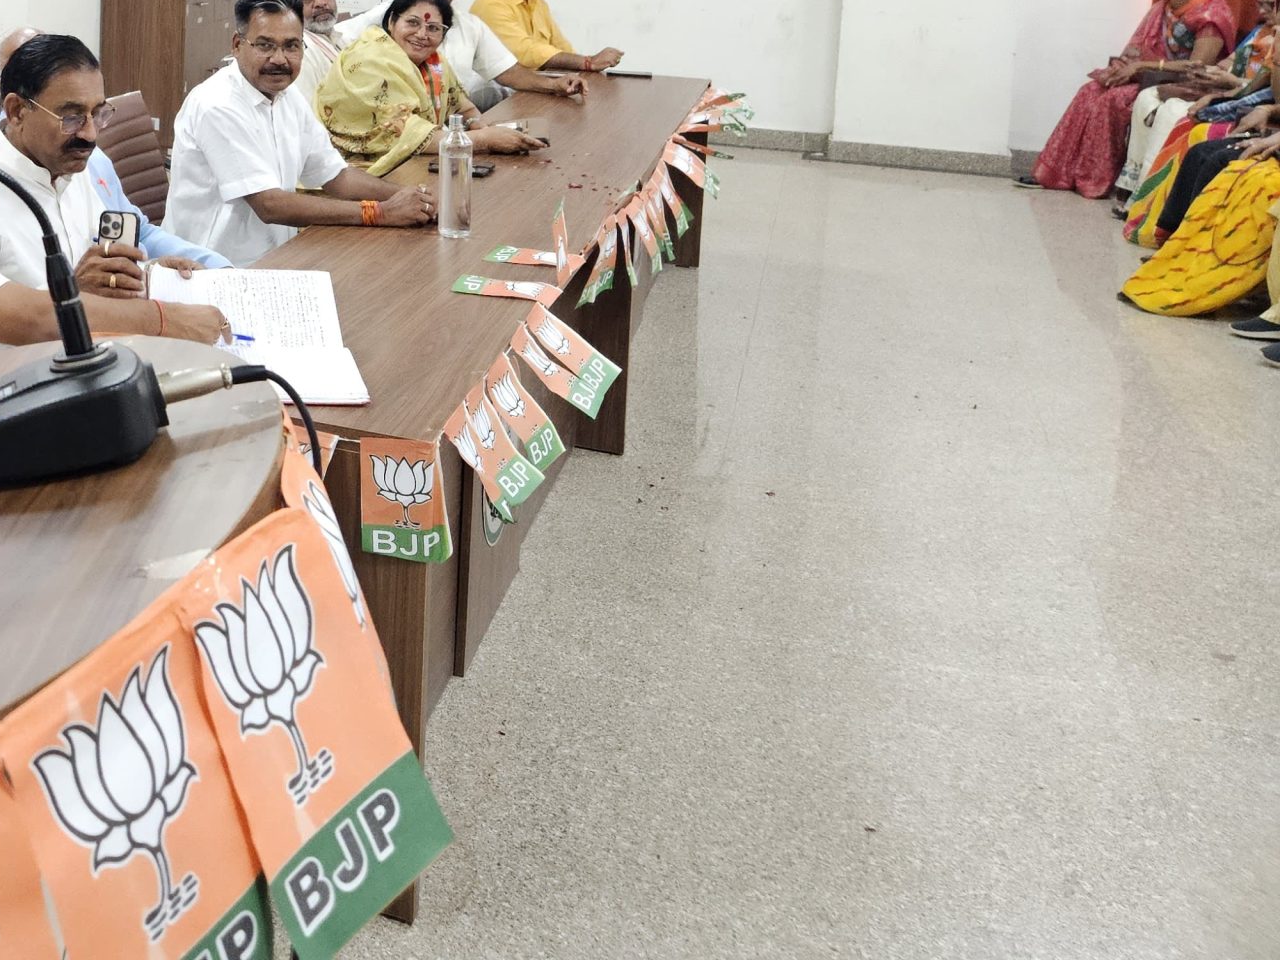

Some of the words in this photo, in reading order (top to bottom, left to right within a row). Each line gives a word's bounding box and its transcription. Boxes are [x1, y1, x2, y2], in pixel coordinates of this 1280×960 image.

[463, 275, 483, 291] JP
[572, 380, 595, 410] BJ
[529, 428, 554, 465] BJP
[499, 461, 530, 497] BJP
[371, 528, 441, 559] BJP
[284, 788, 401, 938] BJP
